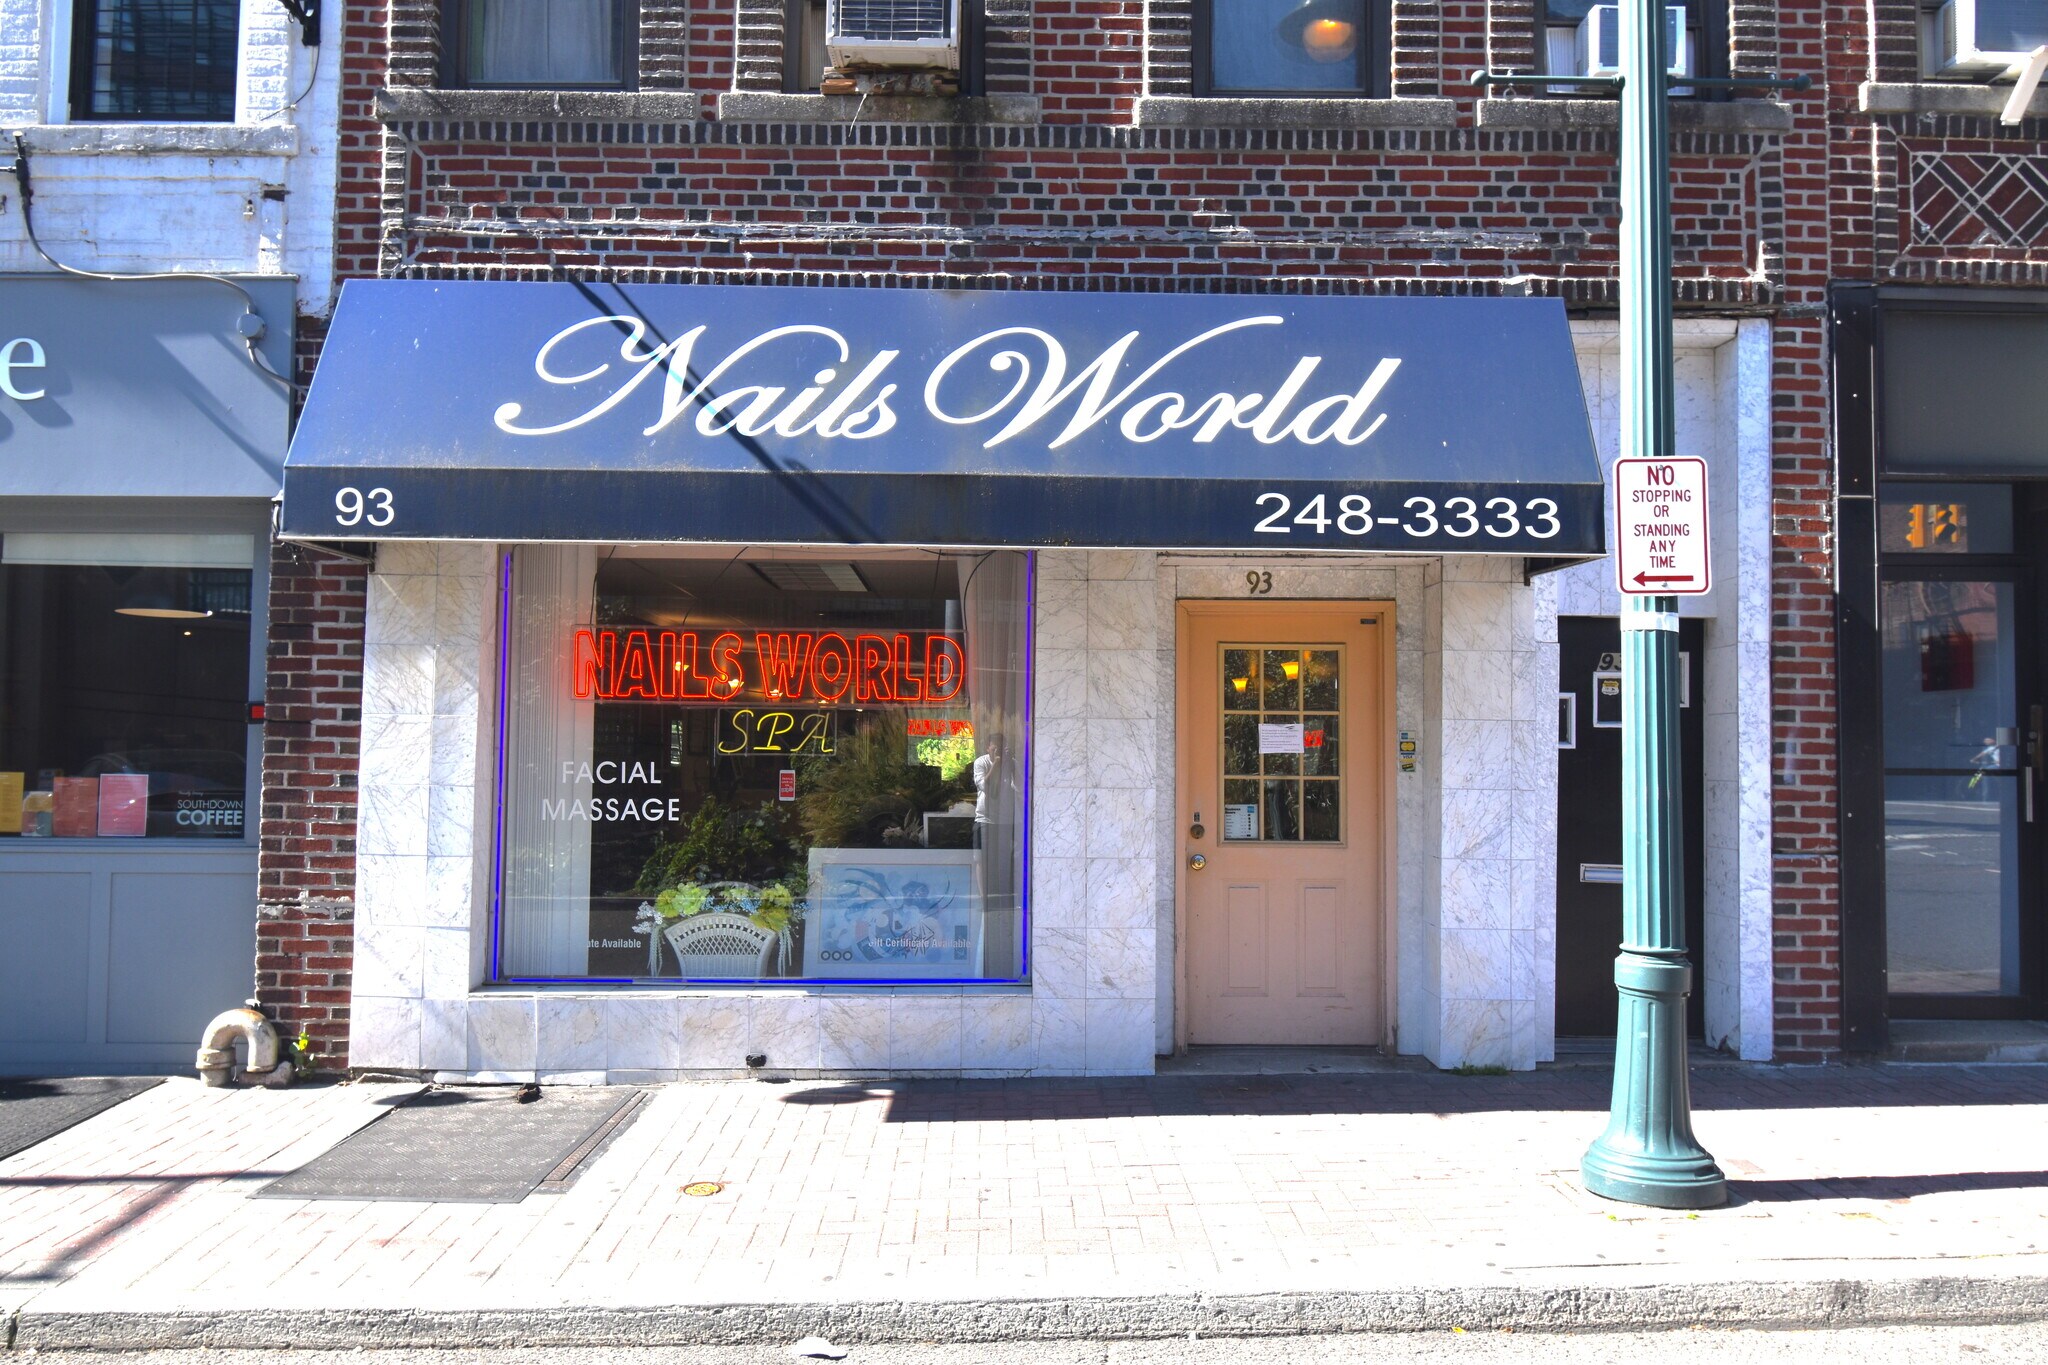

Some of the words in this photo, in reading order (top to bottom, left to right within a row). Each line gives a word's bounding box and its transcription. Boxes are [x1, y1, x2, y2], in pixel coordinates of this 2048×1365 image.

[494, 314, 900, 440] Nails
[924, 315, 1402, 449] World
[1647, 465, 1675, 486] NO
[1632, 489, 1692, 503] STOPPING
[335, 487, 395, 527] 93
[1253, 492, 1561, 539] 248-3333
[1653, 505, 1670, 518] OR
[1633, 524, 1690, 537] STANDING
[1649, 540, 1676, 553] ANY
[1649, 555, 1676, 569] TIME
[1246, 570, 1273, 595] 93
[573, 630, 744, 700] NAILS
[755, 632, 965, 701] WORLD
[718, 709, 834, 754] SPA
[562, 761, 662, 785] FACIAL
[177, 799, 244, 809] SOUTHDOWN
[542, 798, 680, 822] MASSAGE
[176, 809, 243, 826] COFFEE
[601, 938, 642, 948] Available
[885, 937, 929, 948] Certificate
[931, 938, 972, 949] Available
